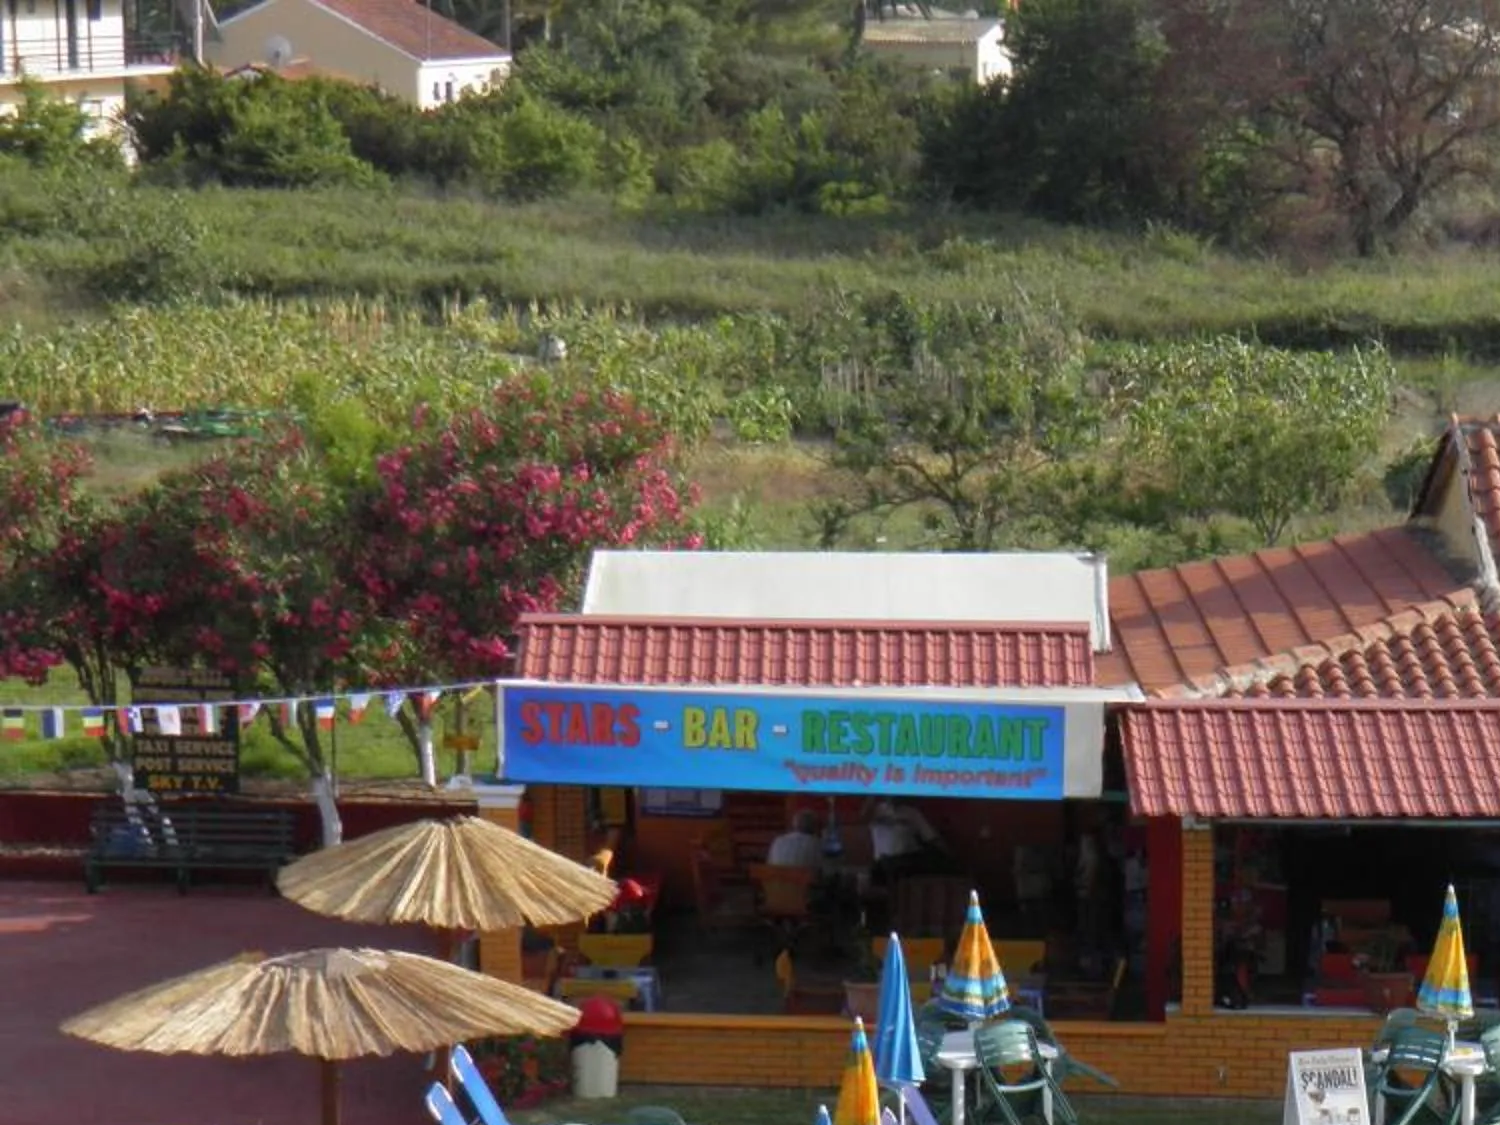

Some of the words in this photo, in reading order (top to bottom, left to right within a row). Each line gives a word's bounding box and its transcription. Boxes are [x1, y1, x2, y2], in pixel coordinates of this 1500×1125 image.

[520, 702, 641, 748] STARS
[682, 706, 758, 751] BAR
[799, 709, 1051, 762] RESTAURANT
[136, 740, 169, 754] TAXI
[175, 741, 235, 755] SERVICE
[133, 756, 172, 772] POST
[177, 758, 235, 773] SERVICE
